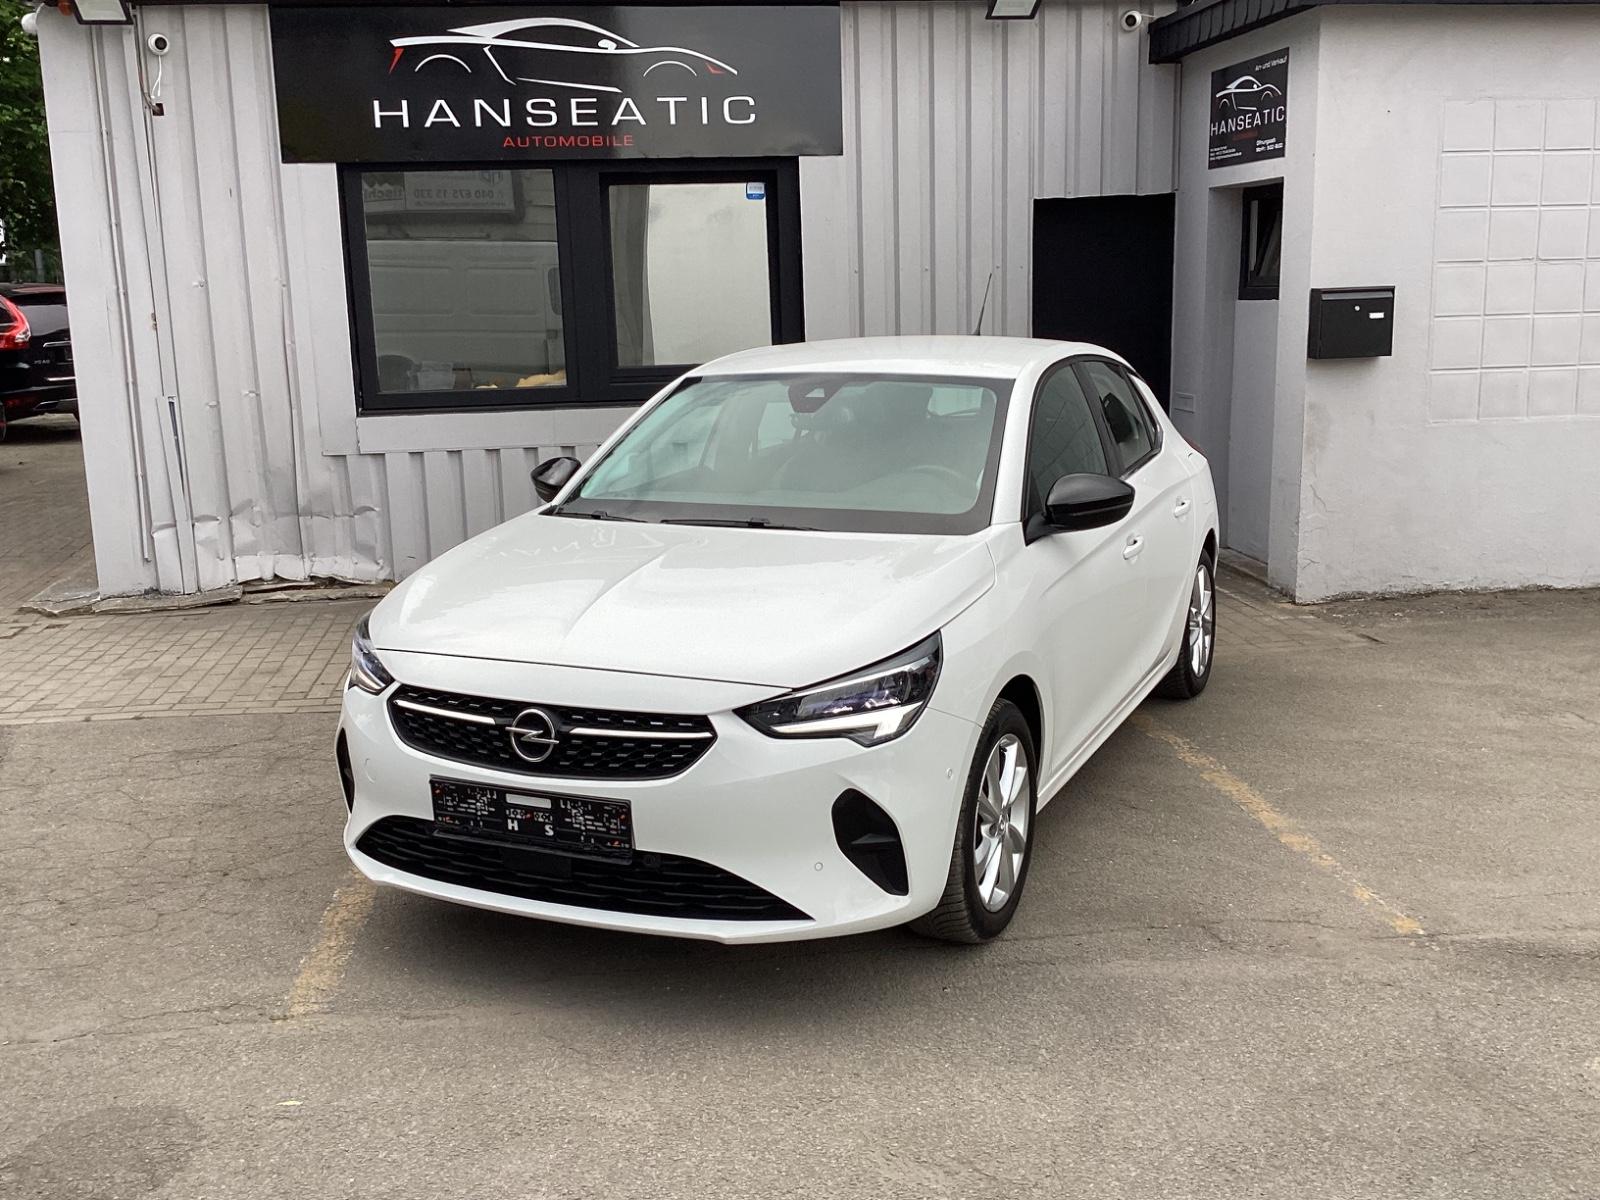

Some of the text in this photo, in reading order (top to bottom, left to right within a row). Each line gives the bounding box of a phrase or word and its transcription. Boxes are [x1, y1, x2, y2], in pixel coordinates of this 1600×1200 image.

[372, 96, 756, 128] HANSEATIC
[1210, 106, 1285, 136] HANSEATIC
[503, 135, 634, 148] AUTOMOBILE
